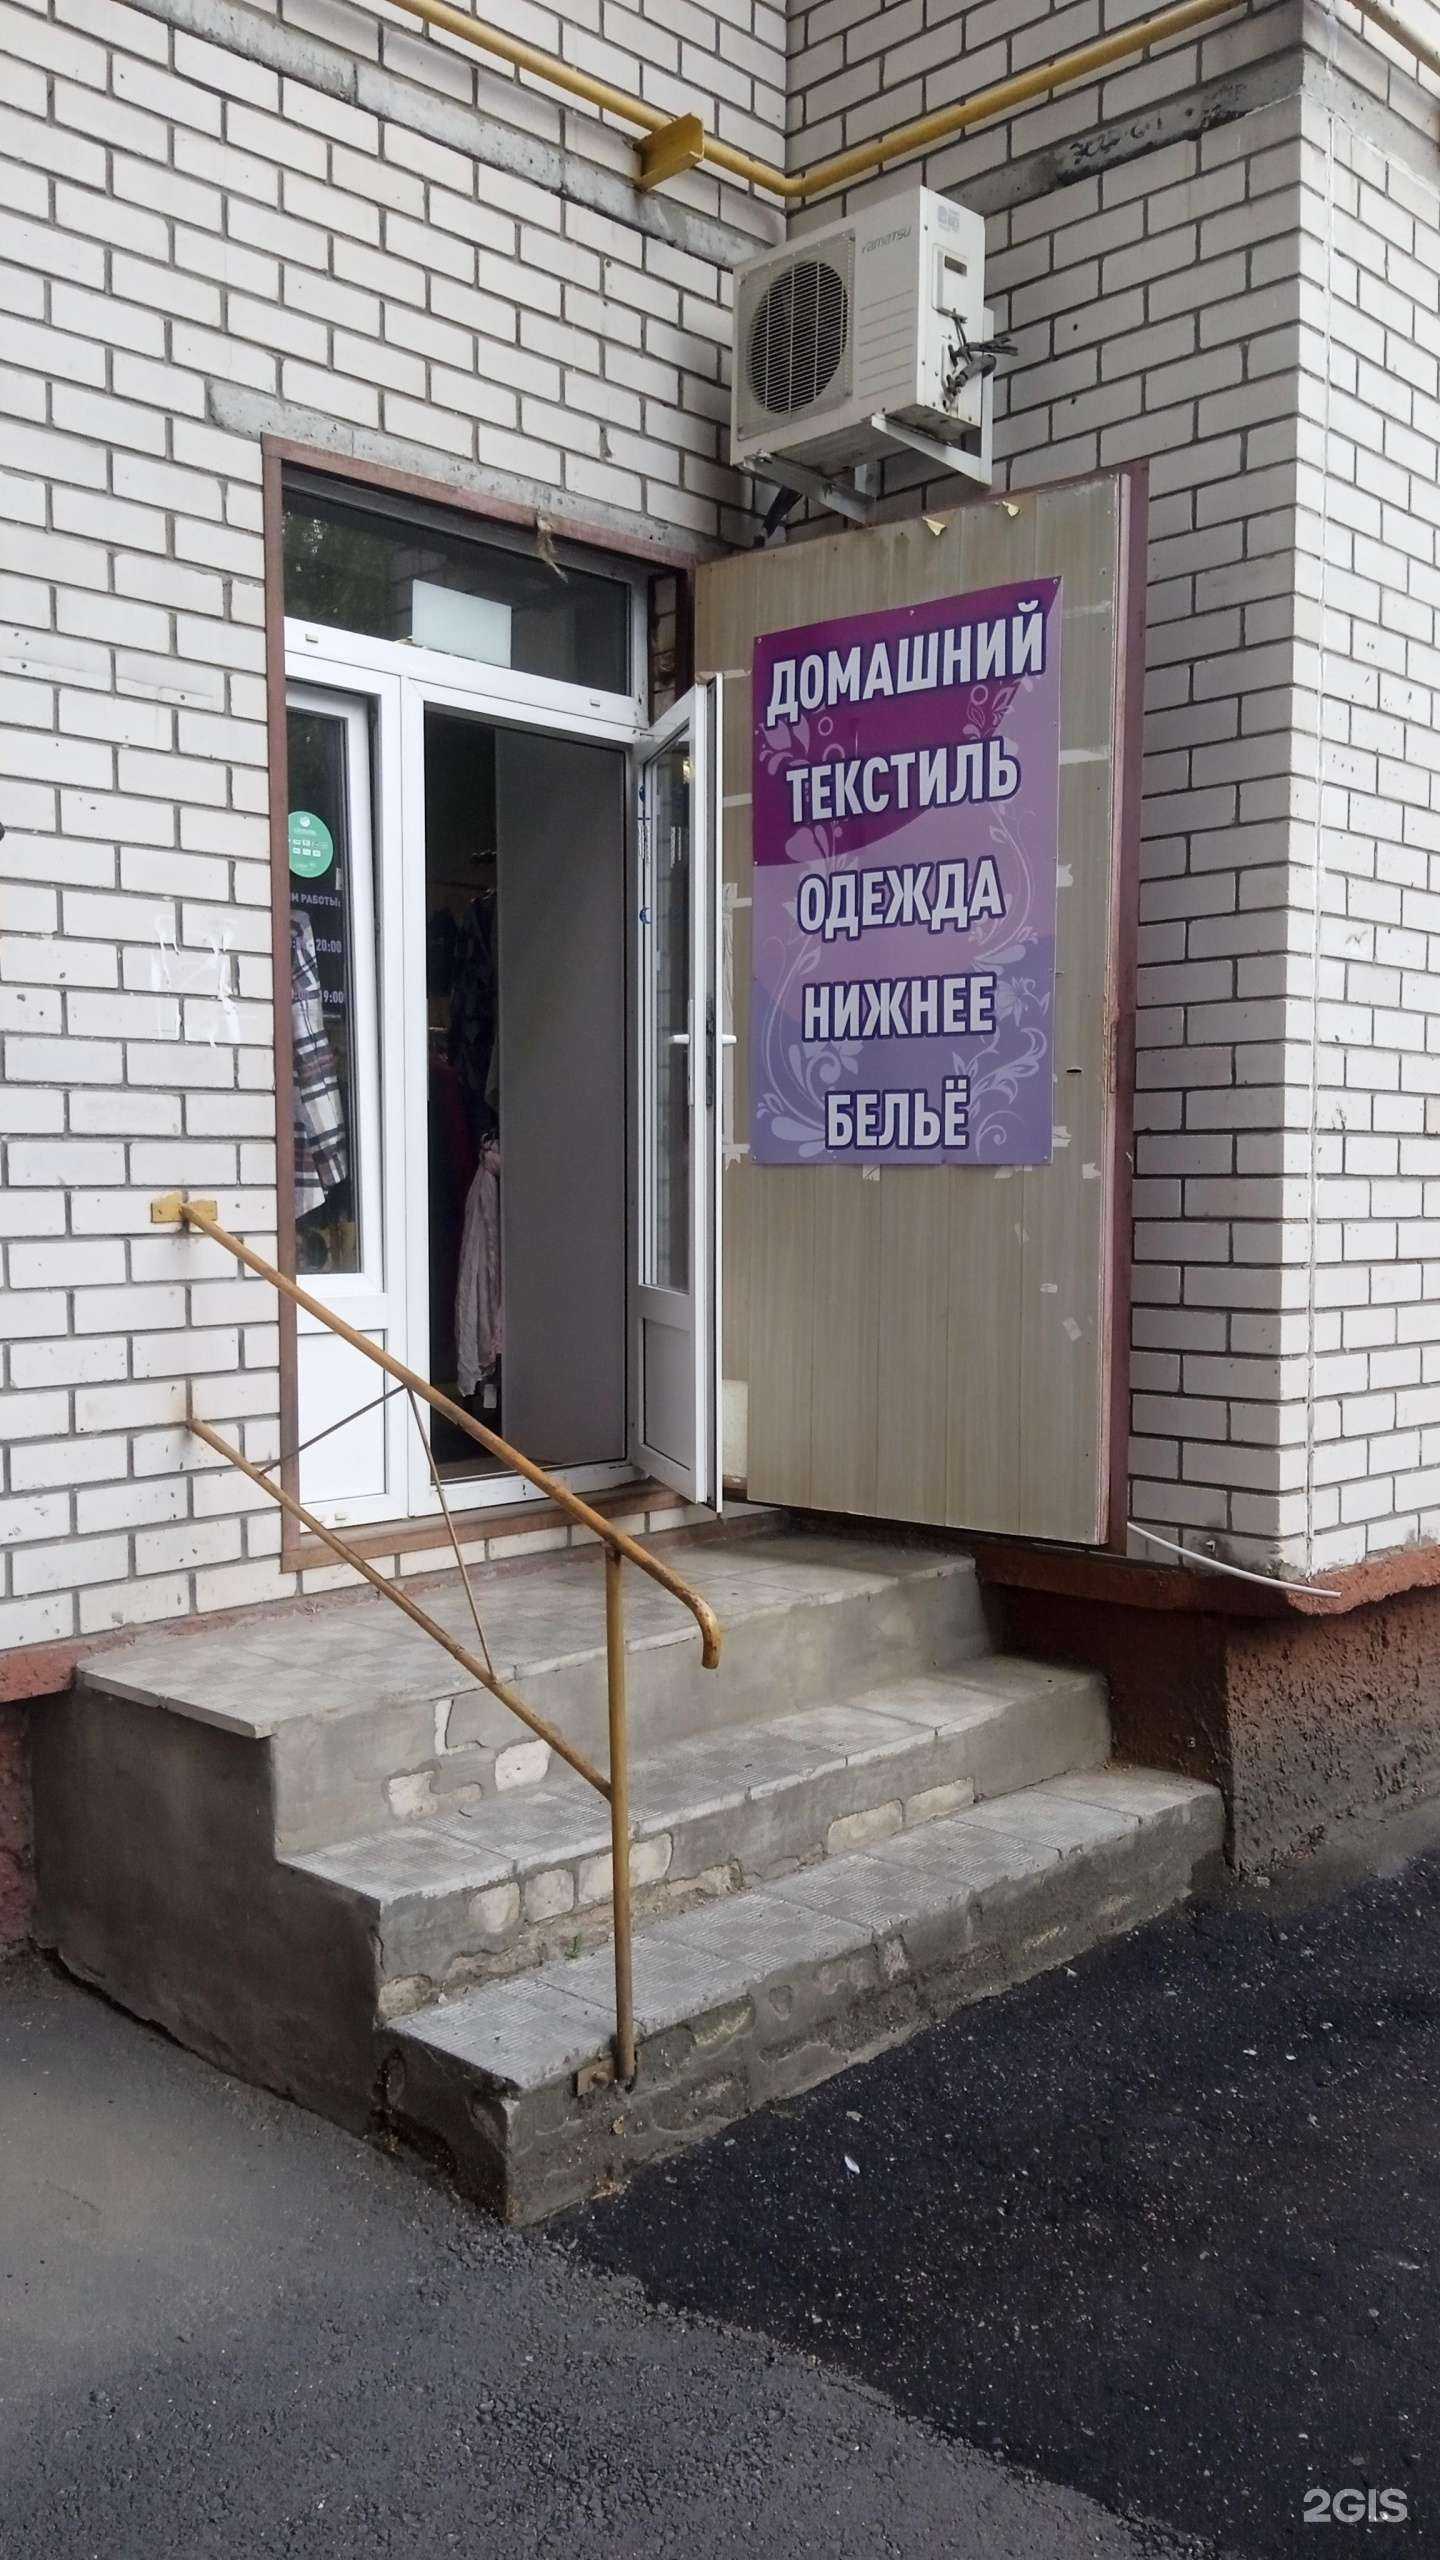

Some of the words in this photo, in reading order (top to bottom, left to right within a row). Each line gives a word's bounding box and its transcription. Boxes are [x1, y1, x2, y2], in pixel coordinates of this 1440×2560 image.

[766, 600, 1045, 727] ДОМАШНИЙ
[786, 738, 1019, 823] ТЕКСТИЛЬ
[799, 859, 1004, 940] ОДЕЖДА
[316, 938, 342, 953] 20:00
[803, 974, 996, 1040] НИЖНЕЕ
[825, 1079, 969, 1148] БЕЛЬЁ
